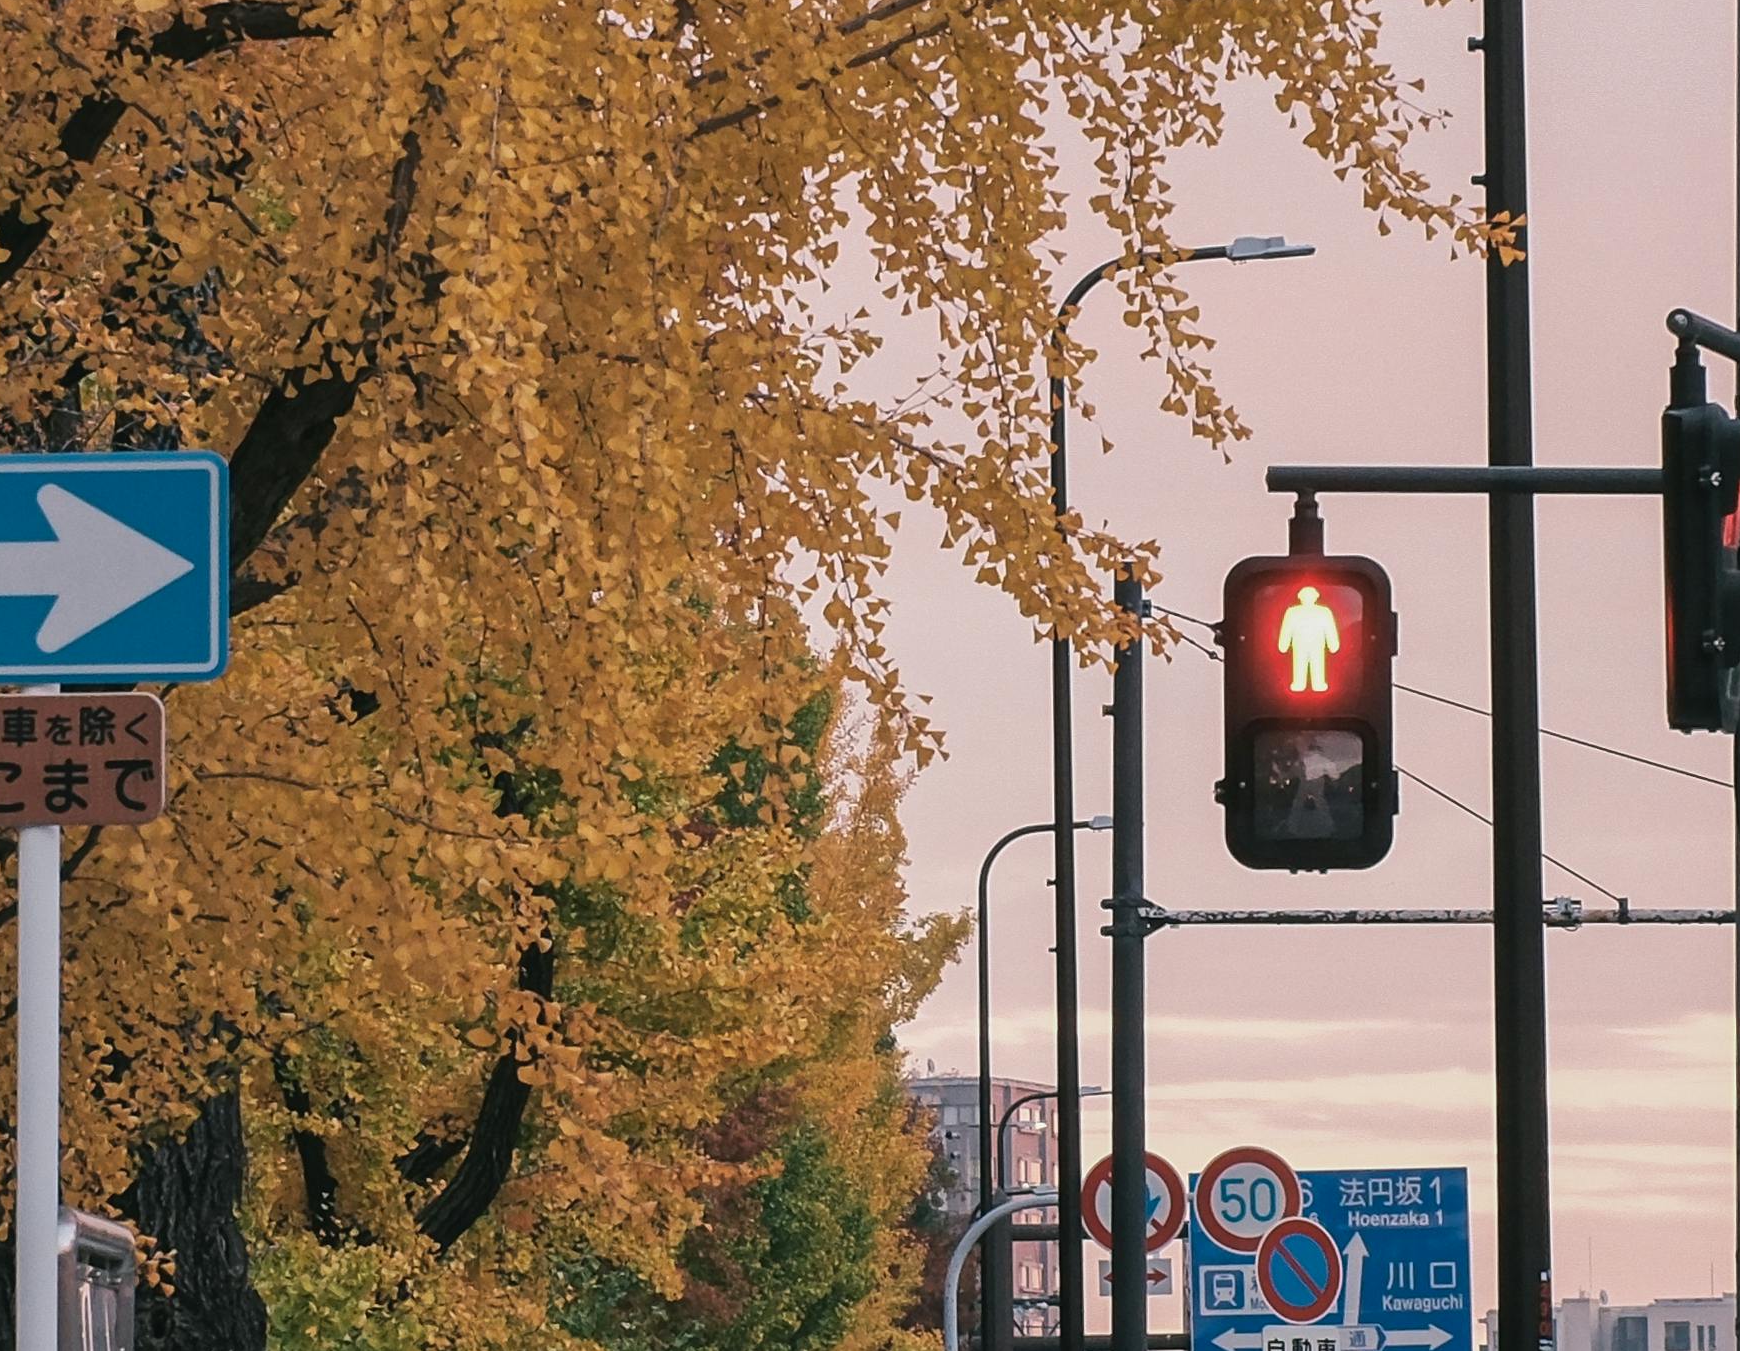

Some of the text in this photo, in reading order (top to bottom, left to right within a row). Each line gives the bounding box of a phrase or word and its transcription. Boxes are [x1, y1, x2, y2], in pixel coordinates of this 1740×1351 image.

[1219, 1177, 1277, 1224] 50
[1347, 1210, 1444, 1228] Hoenzaka 1
[1386, 1261, 1457, 1290] 川口
[1381, 1293, 1464, 1311] Kawaguchi
